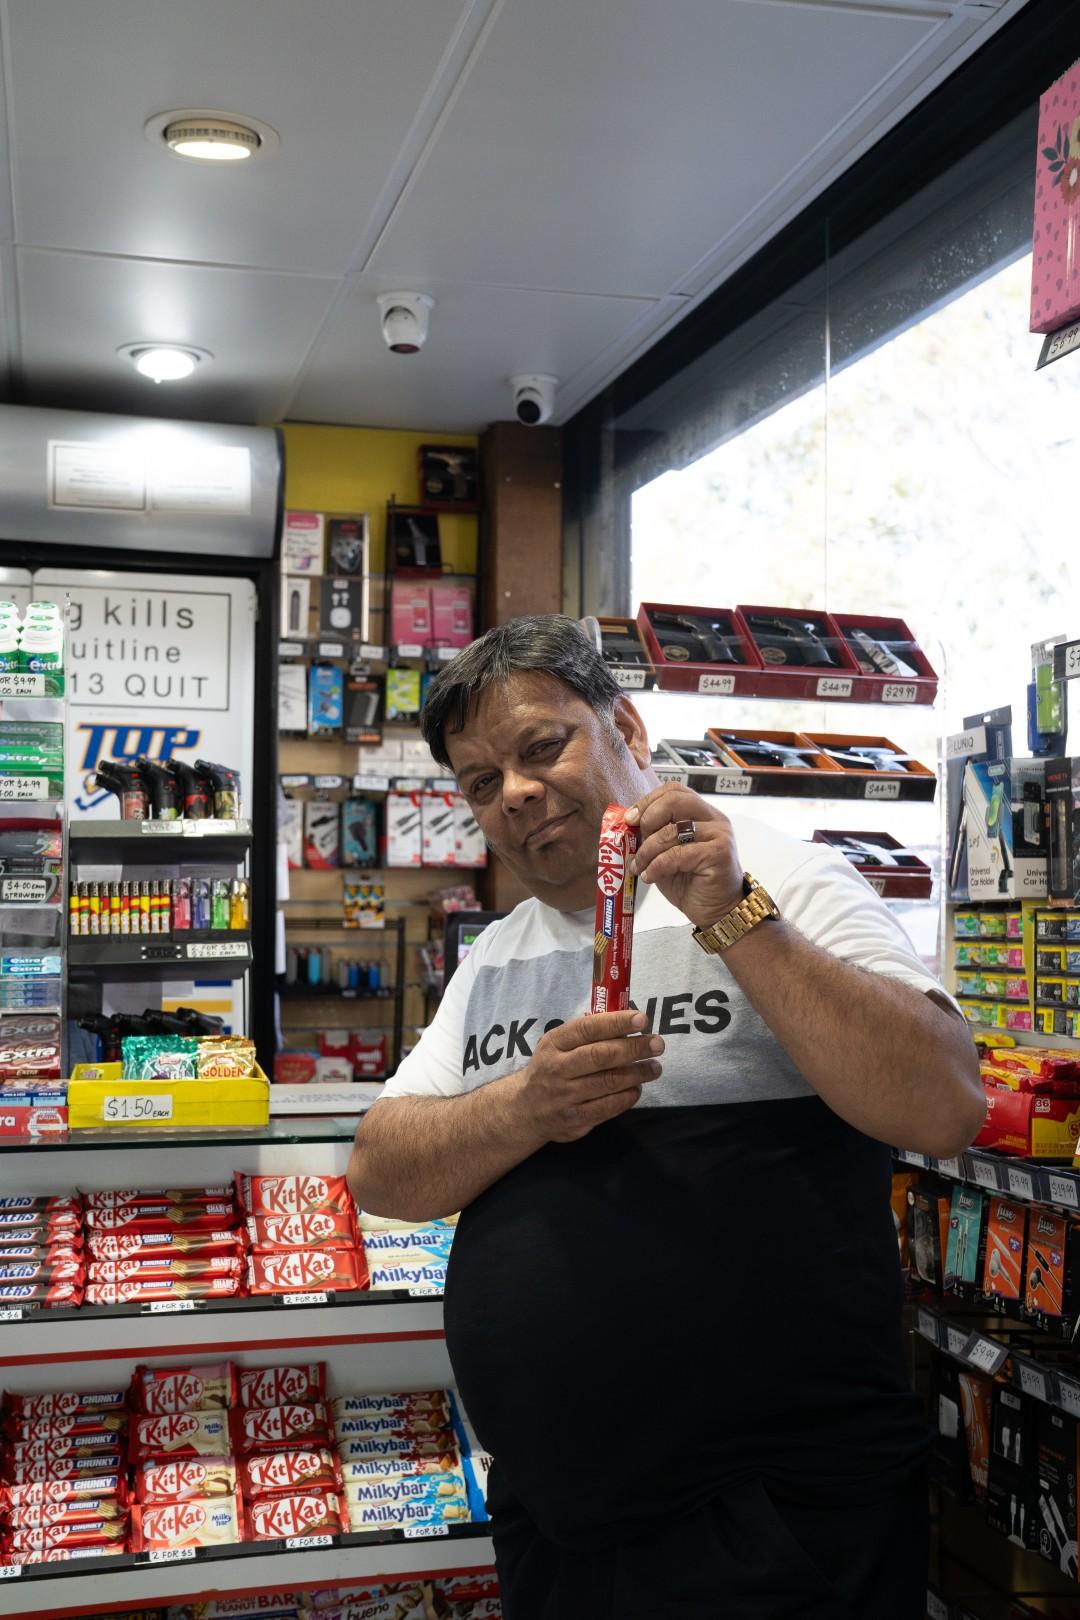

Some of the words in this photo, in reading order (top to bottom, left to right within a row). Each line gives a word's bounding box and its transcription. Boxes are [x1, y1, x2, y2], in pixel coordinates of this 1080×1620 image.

[103, 597, 195, 629] kills
[71, 638, 182, 663] uitline
[70, 672, 104, 695] 13
[124, 674, 209, 699] QUIT
[598, 833, 624, 895] KitKat
[1023, 878, 1038, 886] Car
[604, 898, 614, 936] CHUNKY
[0, 1046, 57, 1063] Extra
[462, 1018, 538, 1077] ACK
[203, 1066, 245, 1078] GOLDEN
[106, 1097, 153, 1119] $1.50
[269, 1176, 326, 1214] KitKat
[0, 1212, 35, 1223] KERS
[93, 1207, 136, 1229] KitKat
[275, 1213, 332, 1244] KitKat
[362, 1233, 441, 1249] Milkybar
[0, 1265, 36, 1278] KERS
[93, 1261, 137, 1283] KitKat
[272, 1252, 332, 1286] KitKat
[0, 1284, 33, 1297] KERS
[93, 1283, 138, 1305] KitKat
[151, 1376, 200, 1415] KitKat
[248, 1368, 304, 1408] KitKat
[29, 1392, 76, 1420] KitKat
[82, 1394, 119, 1405] CHUNKY
[344, 1398, 406, 1411] Milkybar
[28, 1416, 73, 1441] KitKat
[146, 1416, 196, 1444] KitKat
[253, 1407, 310, 1440] KitKat
[341, 1417, 404, 1433] Milkybar
[22, 1437, 69, 1462] KitKat
[75, 1435, 112, 1446] CHUNKY
[350, 1439, 413, 1454] Milkybar
[22, 1459, 71, 1481] KitKat
[77, 1458, 114, 1468] CHUNKY
[152, 1462, 203, 1493] KitKat
[258, 1453, 316, 1485] KitKat
[351, 1460, 416, 1475] Milkybar
[20, 1480, 69, 1506] KitKat
[74, 1478, 112, 1490] CHUNKY
[357, 1482, 428, 1500] Milkybar
[18, 1502, 65, 1529] KitKat
[69, 1501, 99, 1510] CHUNKY
[150, 1505, 202, 1539] KitKat
[263, 1498, 323, 1536] KitKat
[362, 1504, 432, 1522] Milkybar
[21, 1525, 68, 1552] KitKat
[71, 1522, 102, 1531] CHUNKY
[406, 1529, 414, 1537] 2
[415, 1528, 430, 1536] FOR
[432, 1527, 444, 1535] $5
[152, 1552, 160, 1560] 2
[181, 1549, 193, 1557] $5
[289, 1540, 296, 1548] 2
[2, 1566, 16, 1577] $5
[259, 1593, 295, 1608] BAR
[347, 1603, 390, 1620] bueno
